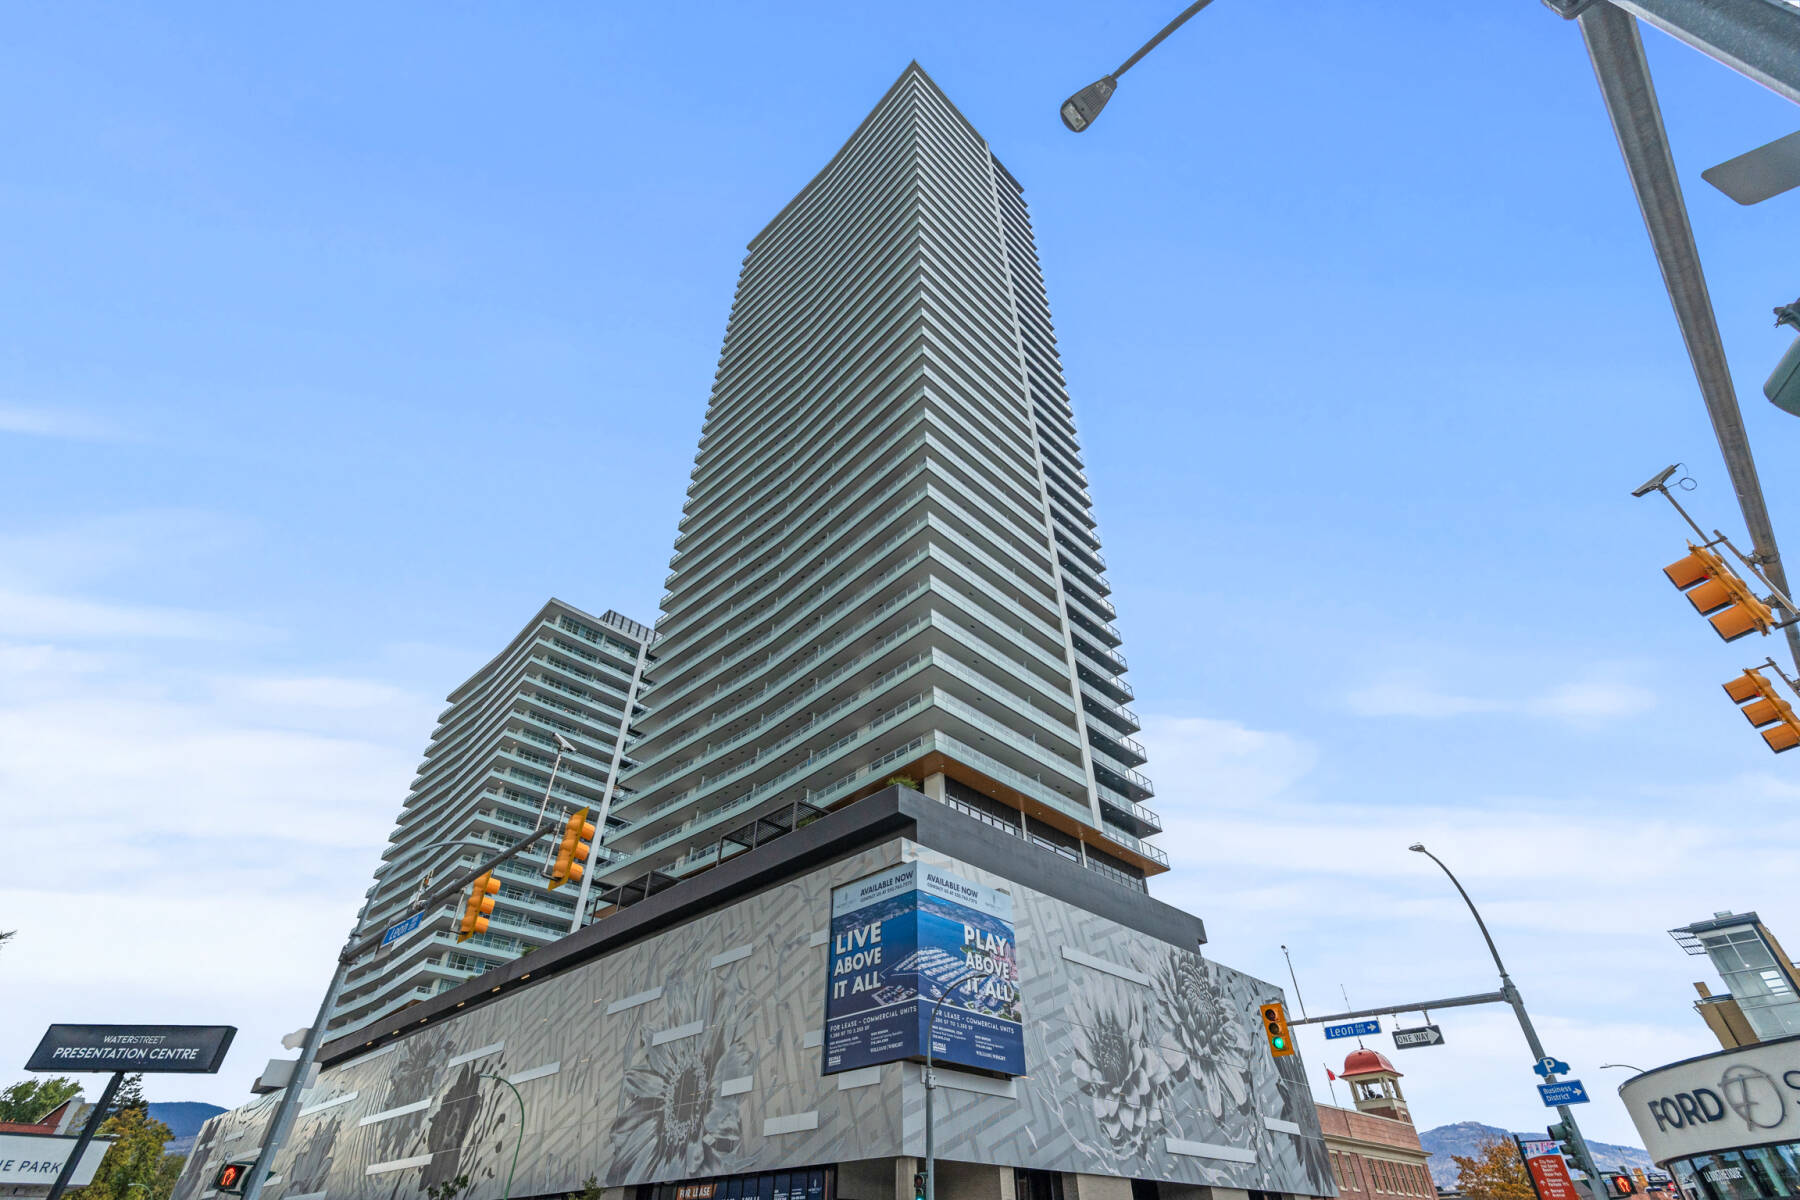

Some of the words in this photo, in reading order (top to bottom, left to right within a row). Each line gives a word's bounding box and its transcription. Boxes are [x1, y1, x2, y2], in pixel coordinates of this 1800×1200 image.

[860, 878, 893, 896] AVAILABLE
[895, 870, 914, 883] NOW
[927, 873, 960, 892] AVAILABLE
[961, 886, 979, 898] NOW
[836, 921, 881, 955] LIVE
[964, 925, 1007, 957] PLAY
[834, 947, 881, 977] ABOVE
[966, 951, 1010, 979] ABOVE
[834, 980, 848, 999] IT
[851, 971, 881, 995] ALL
[966, 974, 979, 994] IT
[985, 980, 1012, 1002] ALL
[830, 1024, 840, 1032] FOR
[841, 1020, 857, 1029] LEASE
[863, 1011, 898, 1025] COMMERCIAL
[900, 1005, 917, 1016] UNITS
[943, 1011, 960, 1020] LEASE
[966, 1016, 999, 1031] COMMERCIAL
[1000, 1025, 1014, 1034] UNITS
[103, 1035, 166, 1044] WATERSTREET
[1330, 1026, 1354, 1038] Leon
[1396, 1034, 1413, 1043] ONE
[1415, 1032, 1430, 1041] WAY
[52, 1047, 147, 1059] PRESENTATION
[150, 1048, 200, 1060] CENTRE
[1543, 1059, 1555, 1072] P
[1543, 1086, 1572, 1094] Business
[1546, 1094, 1570, 1102] District
[1648, 1088, 1723, 1132] FORD
[18, 1160, 63, 1174] PARK
